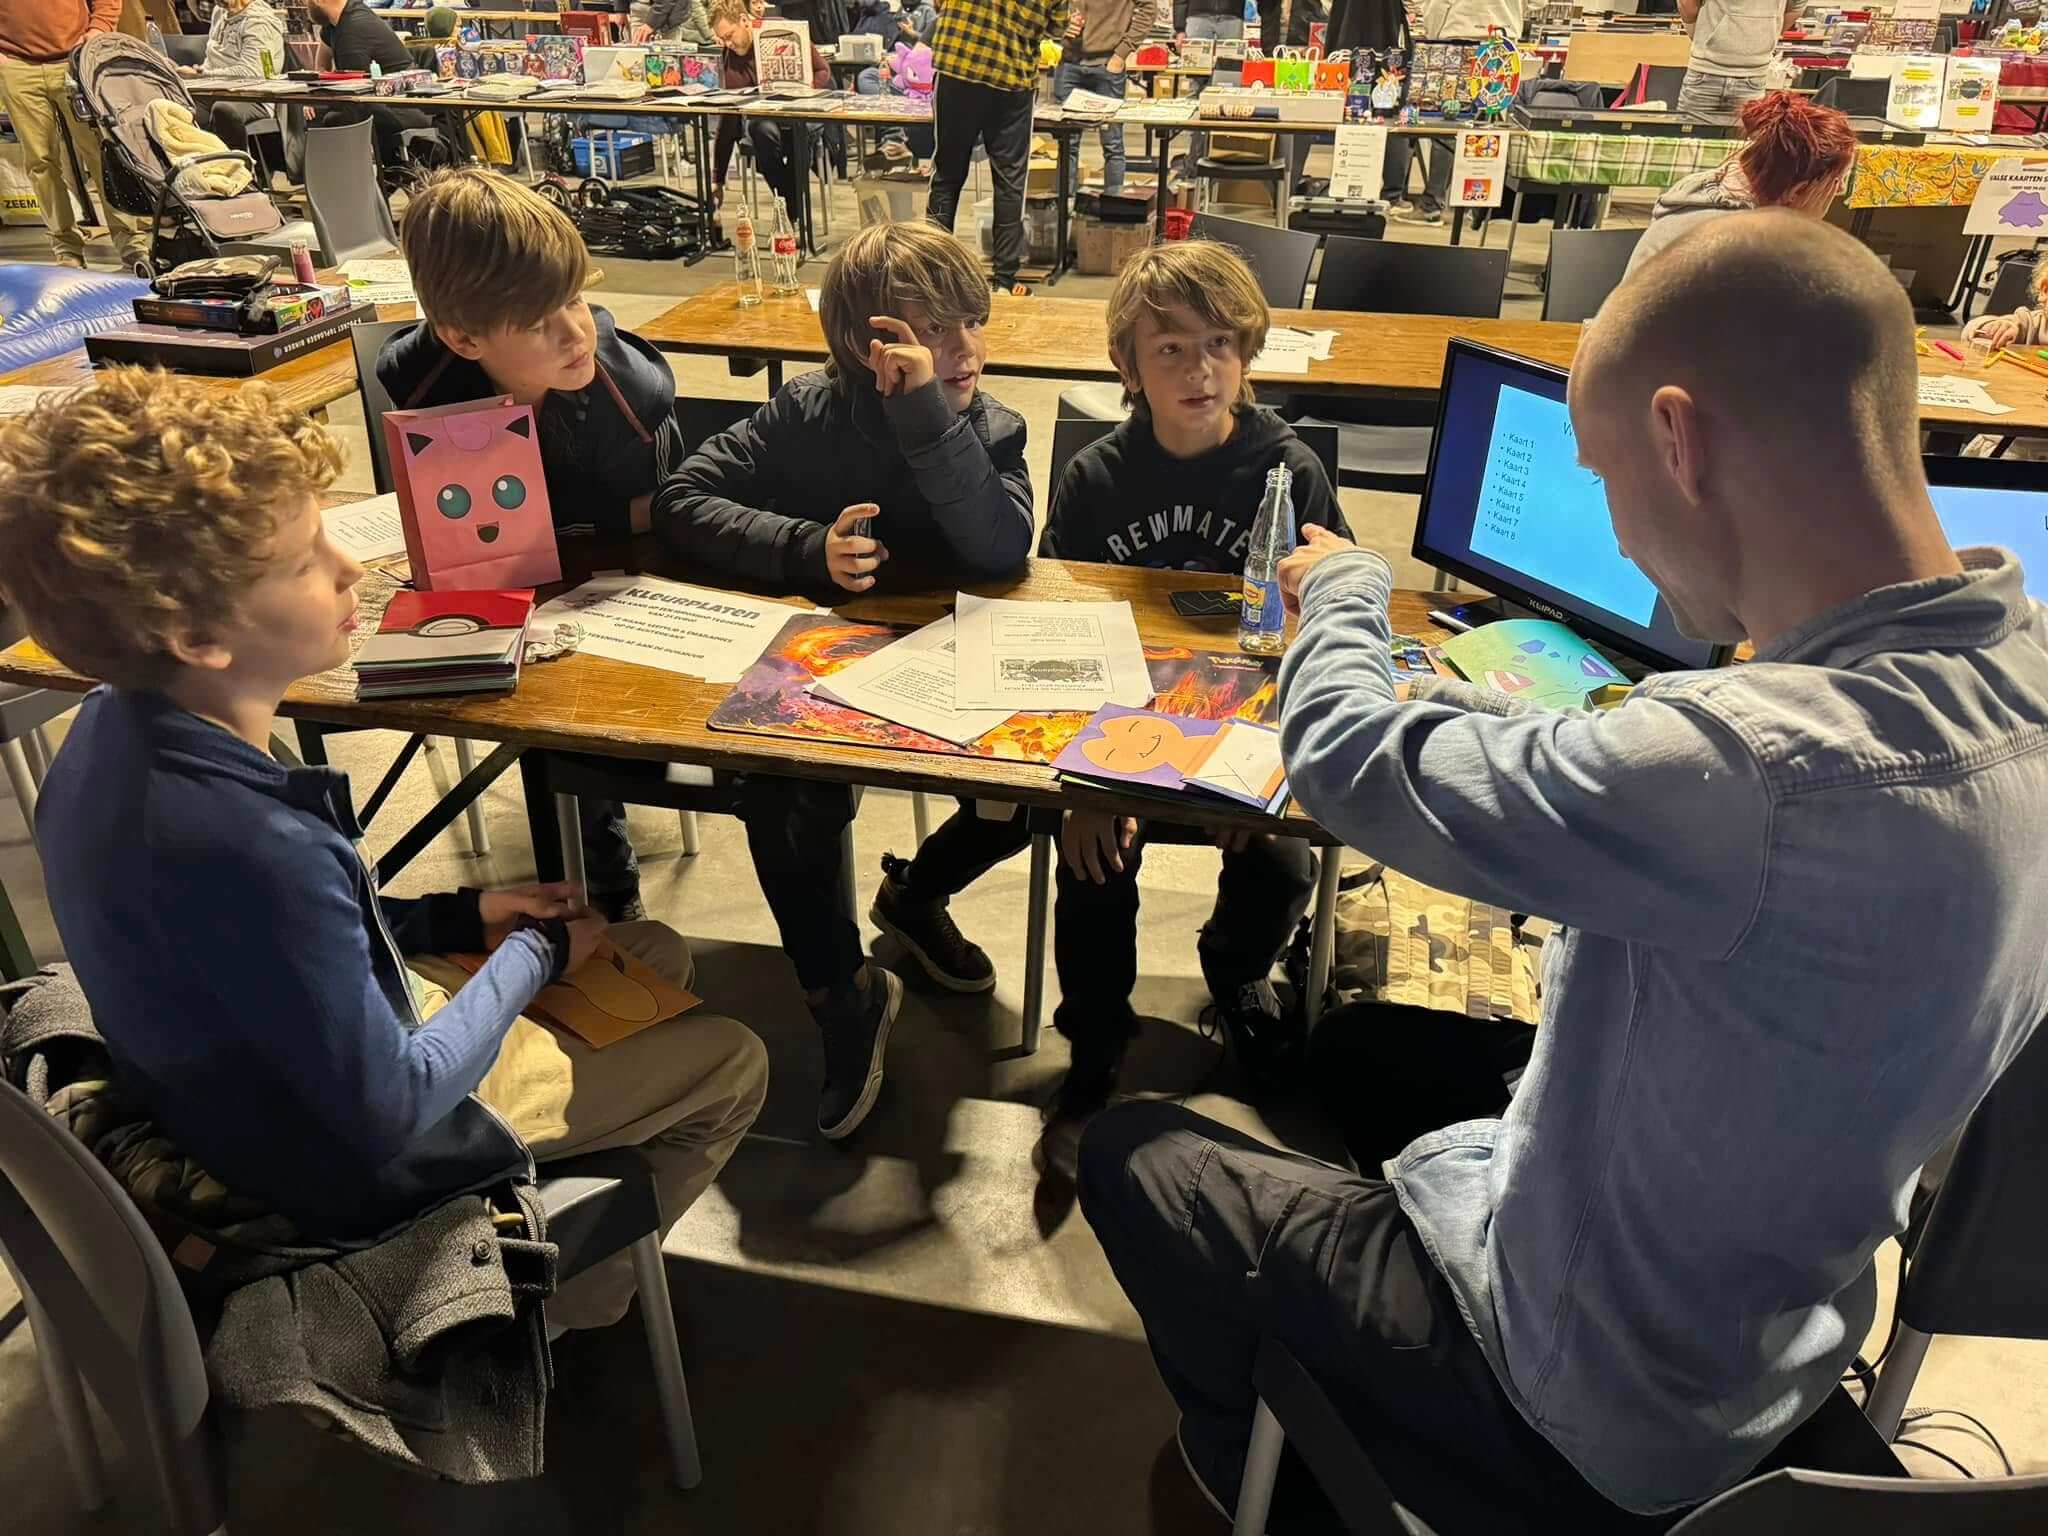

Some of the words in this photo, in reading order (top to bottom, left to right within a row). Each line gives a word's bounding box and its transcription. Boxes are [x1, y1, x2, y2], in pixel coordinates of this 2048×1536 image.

[3, 199, 40, 209] ZEEM
[306, 327, 337, 344] TOPLOADER
[1509, 433, 1529, 448] Kaart
[1506, 446, 1526, 461] Kaart
[1503, 459, 1523, 474] Kaart
[1501, 472, 1521, 487] Kaart
[1498, 485, 1518, 499] Kaart
[1495, 498, 1516, 513] Kaart
[1493, 511, 1513, 526] Kaart
[1106, 504, 1252, 563] REWMATE
[1490, 523, 1510, 538] Kaart
